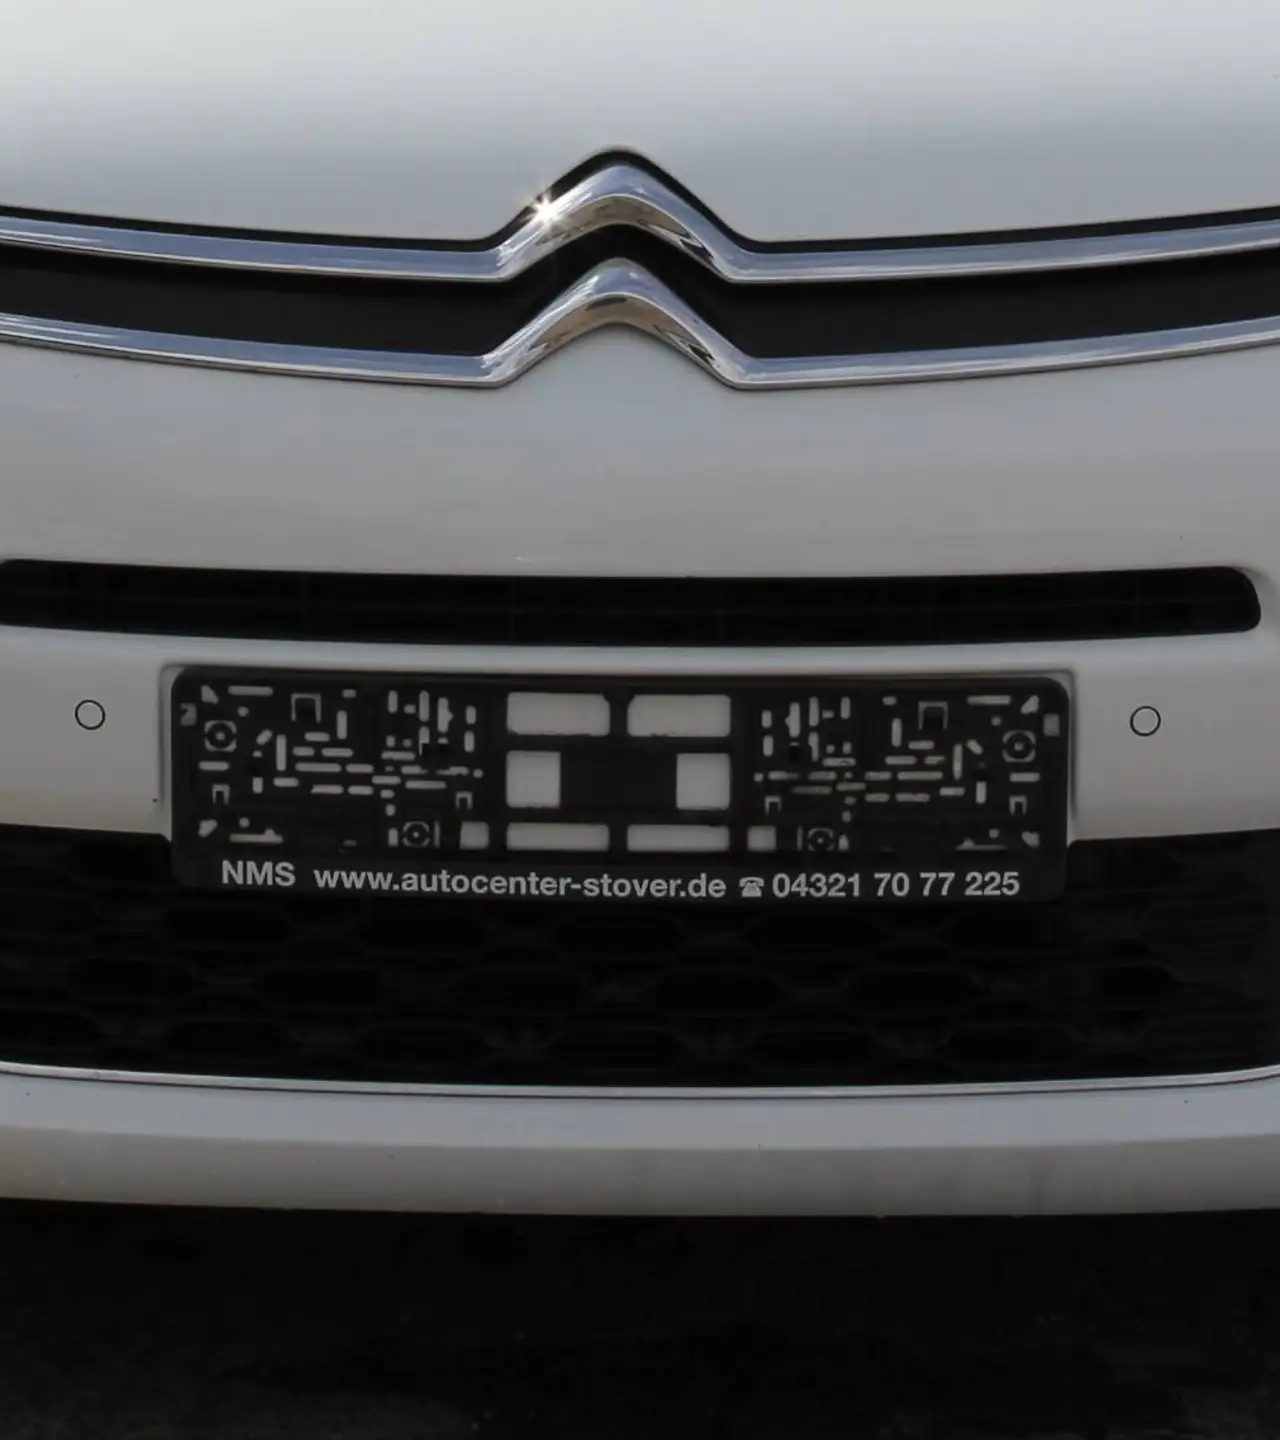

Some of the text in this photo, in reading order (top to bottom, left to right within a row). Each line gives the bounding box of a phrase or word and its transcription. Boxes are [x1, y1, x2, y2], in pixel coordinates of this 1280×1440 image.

[221, 859, 1020, 898] NMS www.autocenter-stover.de 04321 70 77 225
